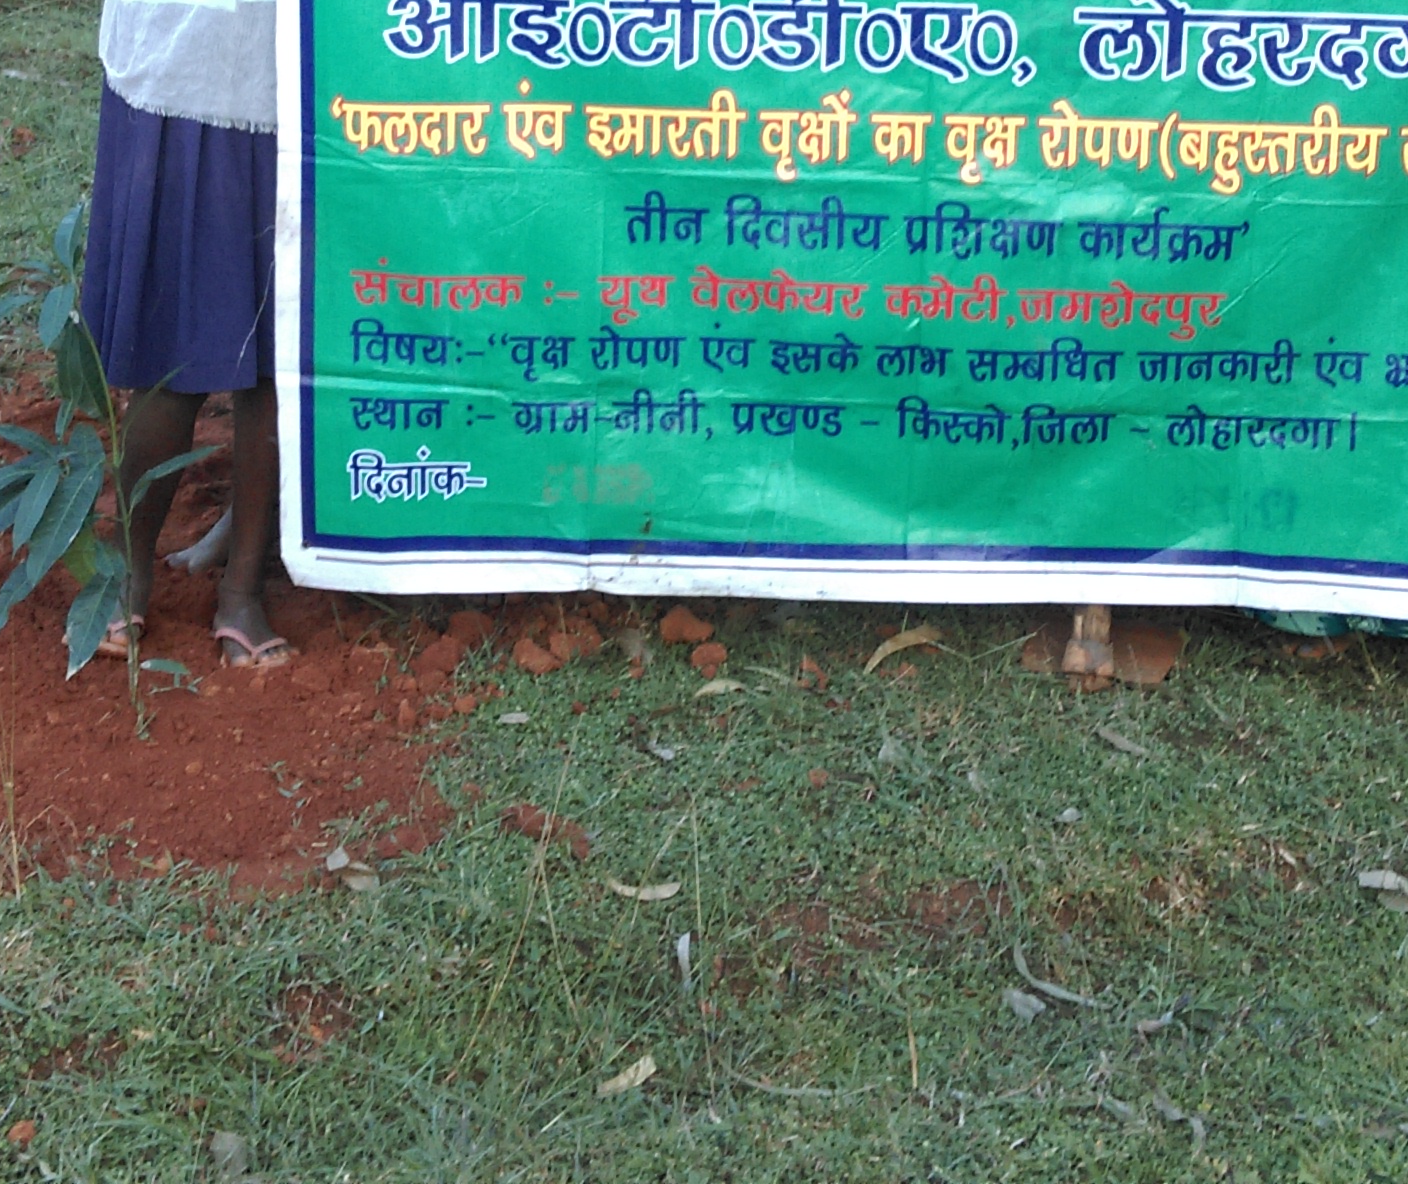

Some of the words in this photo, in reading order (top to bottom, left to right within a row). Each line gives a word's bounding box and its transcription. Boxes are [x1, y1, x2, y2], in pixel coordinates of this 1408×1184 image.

[584, 87, 746, 160] इमारती
[758, 88, 857, 181] वृक्षों
[870, 113, 933, 165] का
[944, 115, 1027, 185] वृक्ष
[624, 190, 710, 244] तीन
[724, 193, 890, 251] दिवसीय
[903, 201, 1064, 260] प्रशिक्षण
[350, 256, 526, 311] संचालक
[596, 275, 676, 326] यूथ
[689, 265, 868, 320] वेलफेयर
[588, 324, 687, 370] रोपण
[769, 332, 863, 374] इसके
[875, 344, 953, 378] लाभ
[966, 336, 1124, 383] सम्बधित
[1137, 338, 1301, 385] जानकारी
[349, 396, 450, 432] स्थान
[731, 402, 847, 437] प्रखण्ड
